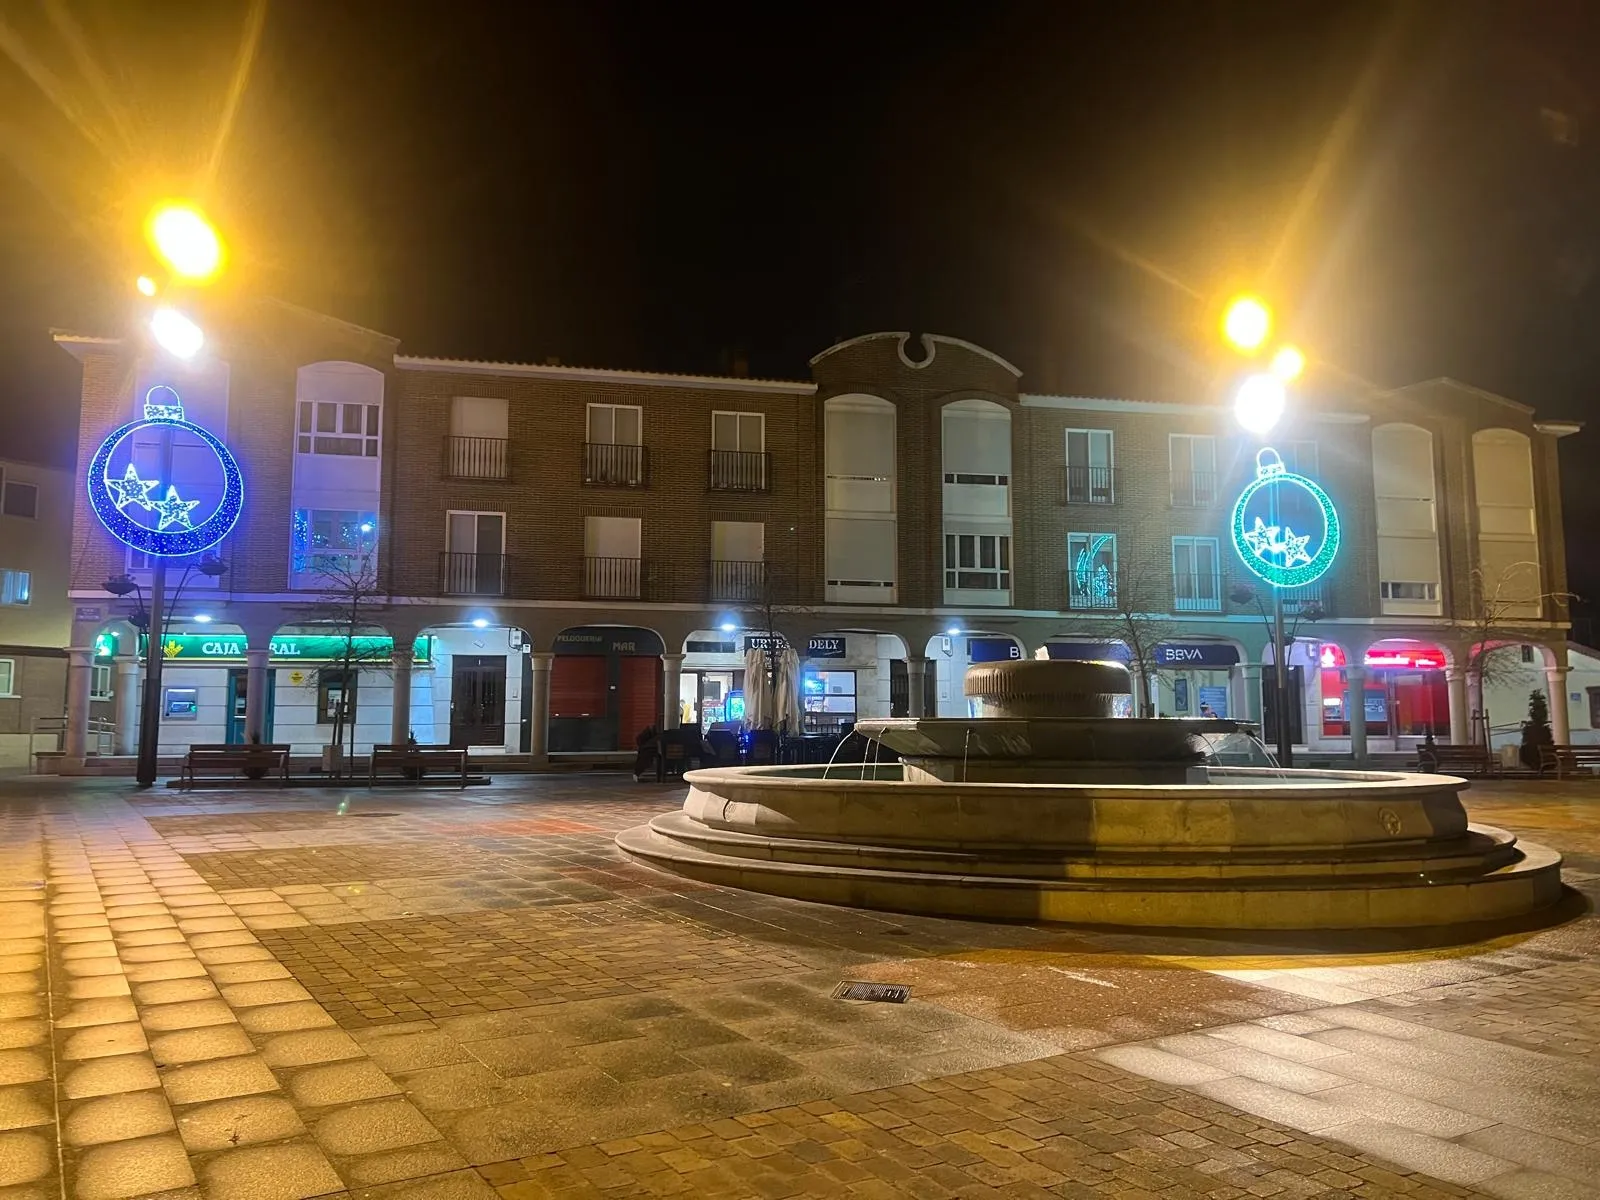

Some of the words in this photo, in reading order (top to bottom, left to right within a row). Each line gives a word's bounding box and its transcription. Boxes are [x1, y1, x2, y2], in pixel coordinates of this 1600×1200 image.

[202, 642, 240, 655] CAJA
[246, 642, 300, 655] RAL
[808, 639, 839, 650] DELY
[1165, 648, 1203, 661] BBVA
